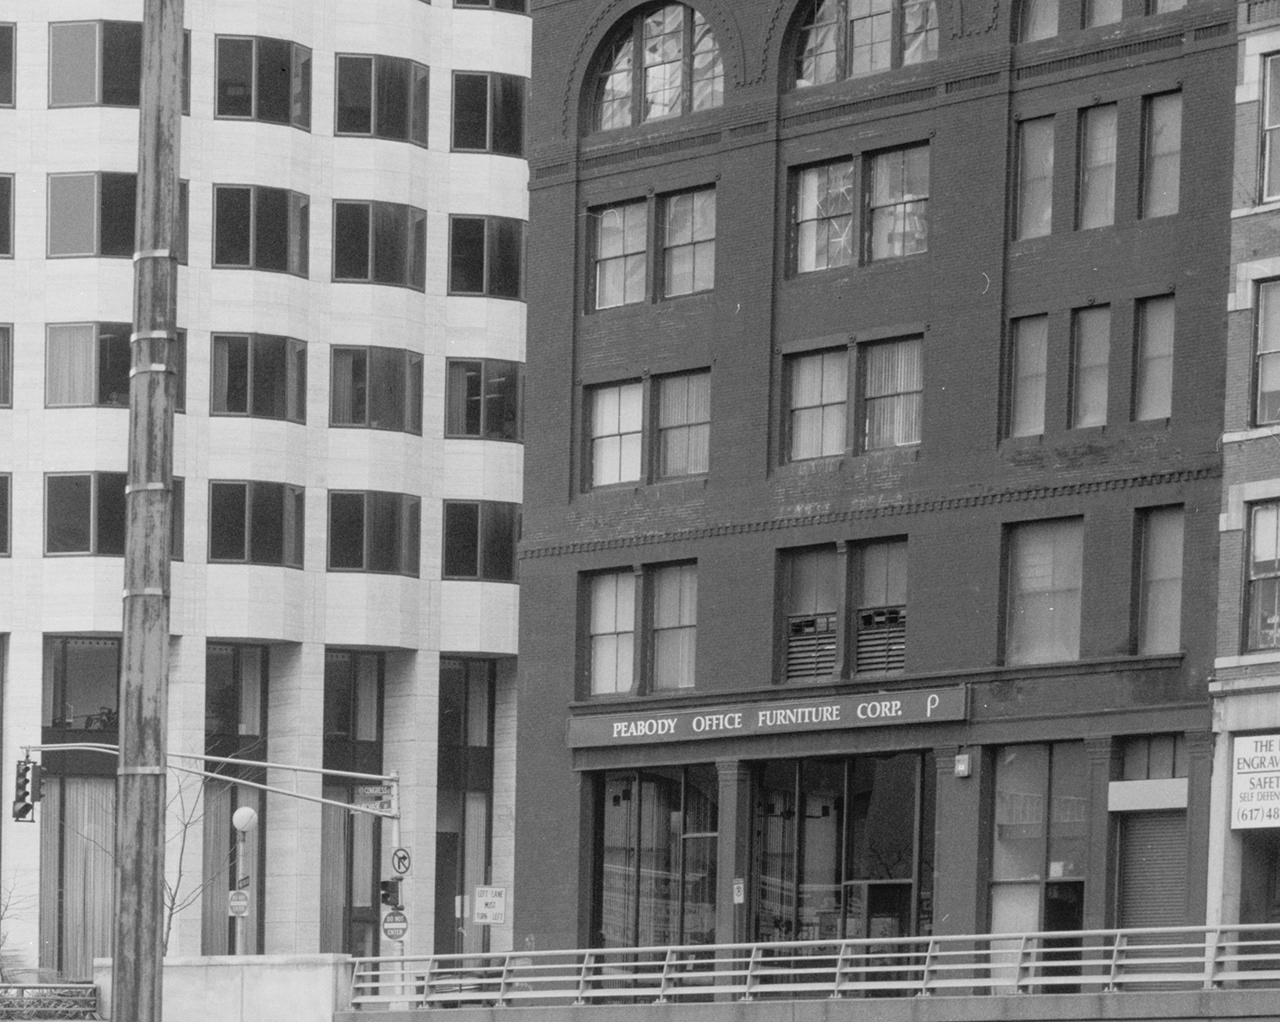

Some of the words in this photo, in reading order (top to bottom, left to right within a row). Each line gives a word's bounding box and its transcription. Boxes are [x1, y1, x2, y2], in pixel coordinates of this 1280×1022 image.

[612, 718, 678, 737] PEABODY
[692, 713, 743, 732] OFFICE
[757, 705, 841, 727] FURNITURE
[856, 700, 903, 719] CORP.
[1253, 740, 1275, 753] THE
[1239, 792, 1255, 802] SELF
[477, 889, 488, 898] LEFT
[491, 890, 503, 898] LANE
[386, 915, 394, 923] DO
